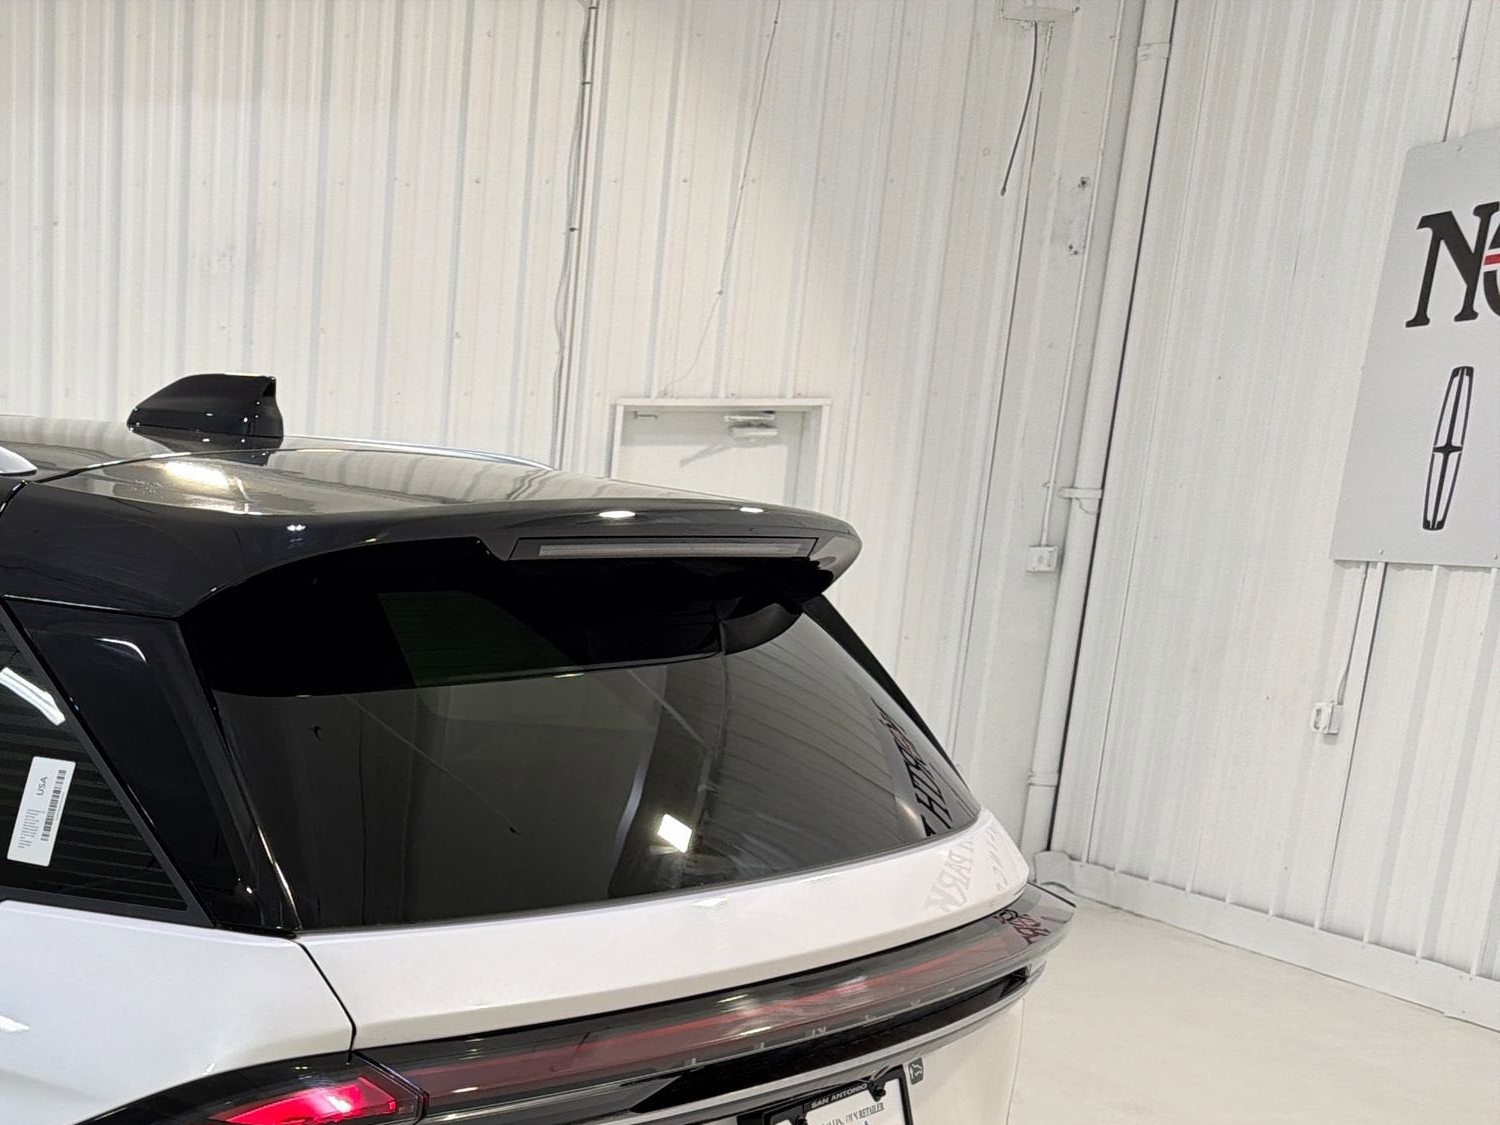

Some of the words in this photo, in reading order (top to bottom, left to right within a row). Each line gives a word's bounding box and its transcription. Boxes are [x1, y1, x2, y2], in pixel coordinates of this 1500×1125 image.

[36, 776, 49, 796] USA
[811, 1097, 830, 1109] SAN
[831, 1083, 868, 1101] ANTONIO
